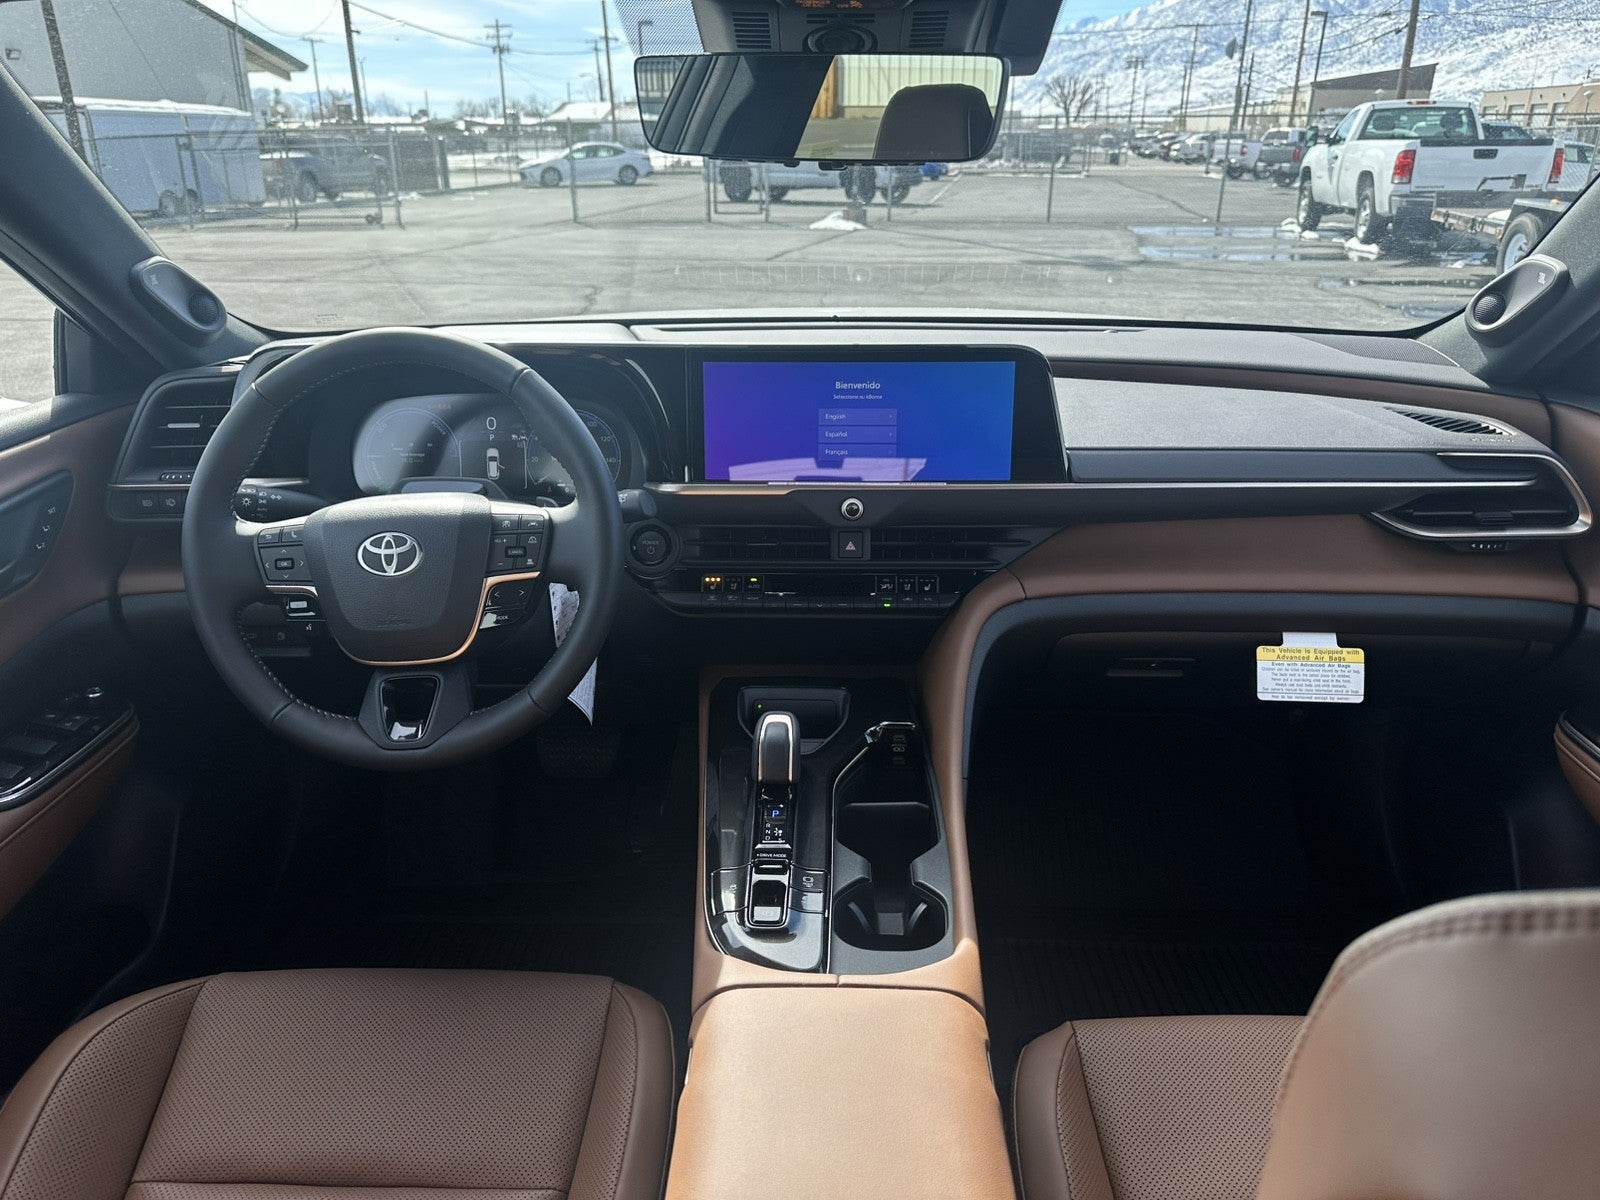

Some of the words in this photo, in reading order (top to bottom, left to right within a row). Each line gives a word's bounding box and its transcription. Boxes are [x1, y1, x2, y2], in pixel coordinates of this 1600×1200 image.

[835, 381, 881, 390] Bienvenido
[486, 416, 497, 430] 0
[772, 810, 780, 818] P
